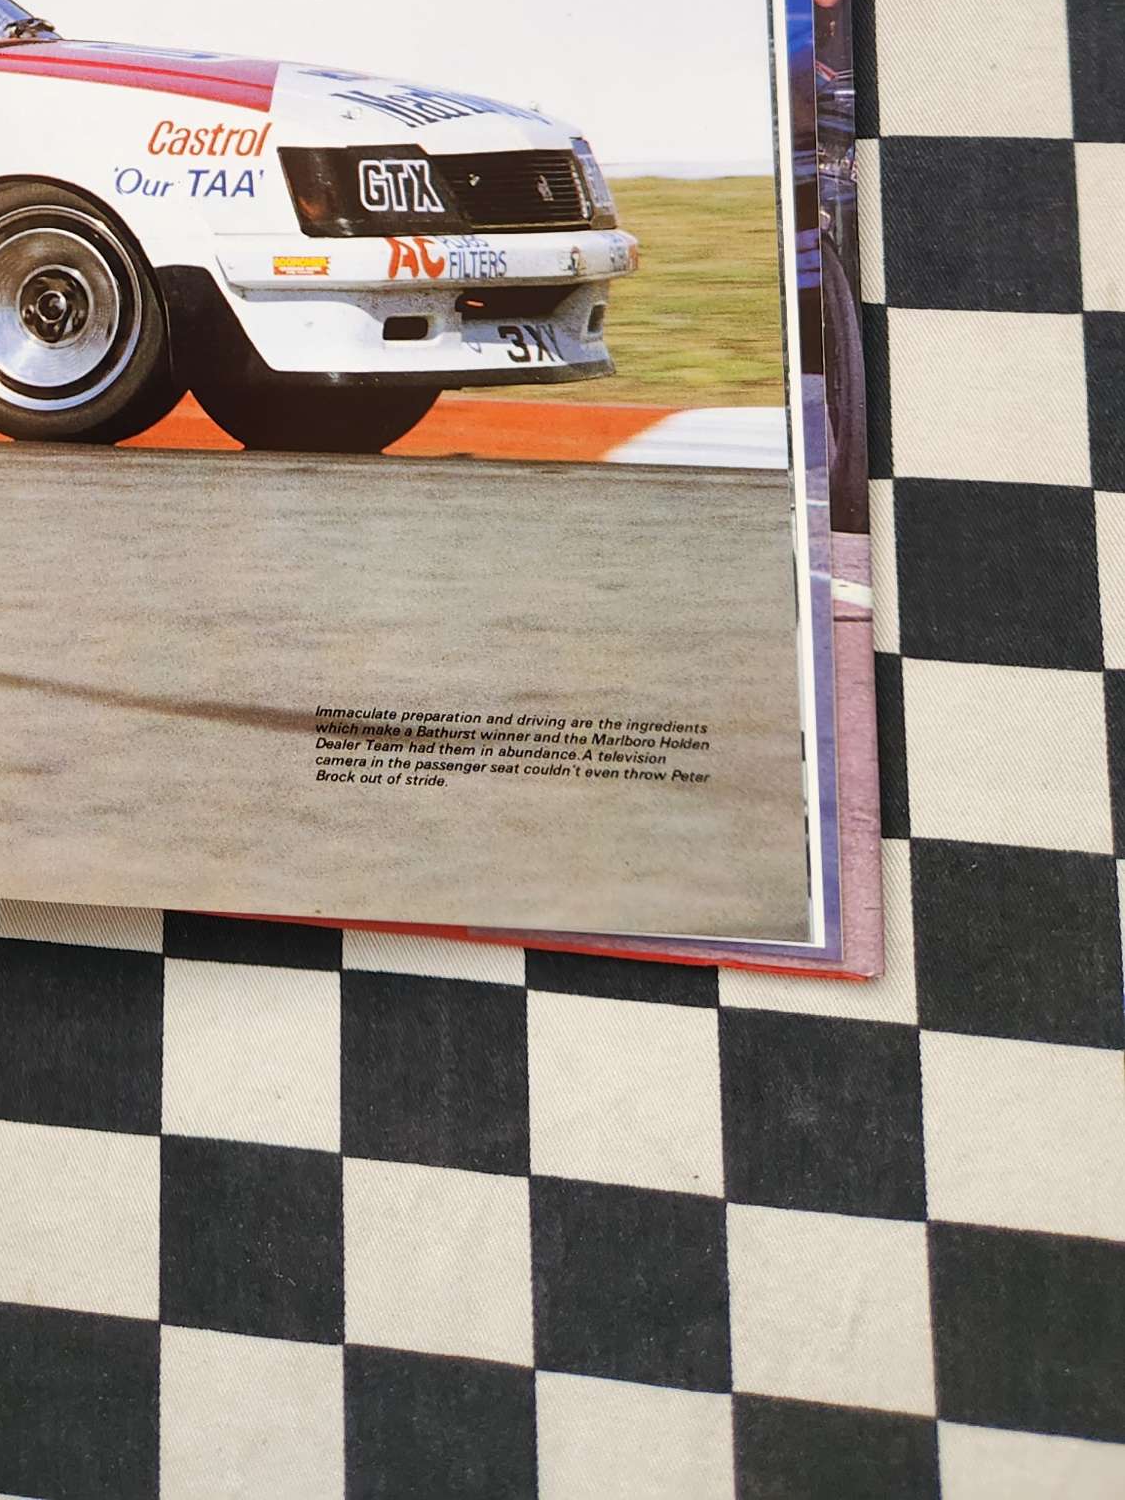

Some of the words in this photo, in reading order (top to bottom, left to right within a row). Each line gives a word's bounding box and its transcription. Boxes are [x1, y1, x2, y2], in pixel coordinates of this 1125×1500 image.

[147, 120, 273, 156] Castrol
[358, 159, 445, 212] GTX
[384, 236, 446, 280] AC
[449, 250, 508, 279] FILTERS
[315, 705, 397, 720] Immaculate
[401, 710, 481, 723] preparation
[486, 713, 512, 725] and
[517, 714, 566, 729] driving
[570, 718, 593, 729] are
[598, 718, 622, 730] the
[626, 718, 708, 734] ingredients
[315, 722, 358, 735] which
[362, 723, 401, 737] make
[404, 727, 412, 737] a
[416, 725, 476, 740] Bathurst
[480, 730, 531, 742] winner
[533, 731, 560, 744] and
[564, 733, 587, 745] the
[591, 733, 656, 748] Marlboro
[659, 736, 710, 750] Holden
[315, 737, 361, 750] Dealer
[366, 739, 403, 752] Team
[408, 741, 434, 754] had
[439, 743, 475, 756] them
[480, 744, 493, 757] in
[598, 750, 667, 765] television
[315, 756, 366, 767] camera
[370, 755, 383, 768] in
[388, 757, 411, 769] the
[414, 761, 487, 775] passenger
[490, 762, 520, 775] seat
[585, 768, 619, 779] even
[624, 768, 667, 781] throw
[671, 769, 711, 783] Peter
[316, 769, 356, 783] Brock
[360, 772, 382, 784] out
[387, 772, 402, 785] of
[405, 774, 449, 787] stride.
